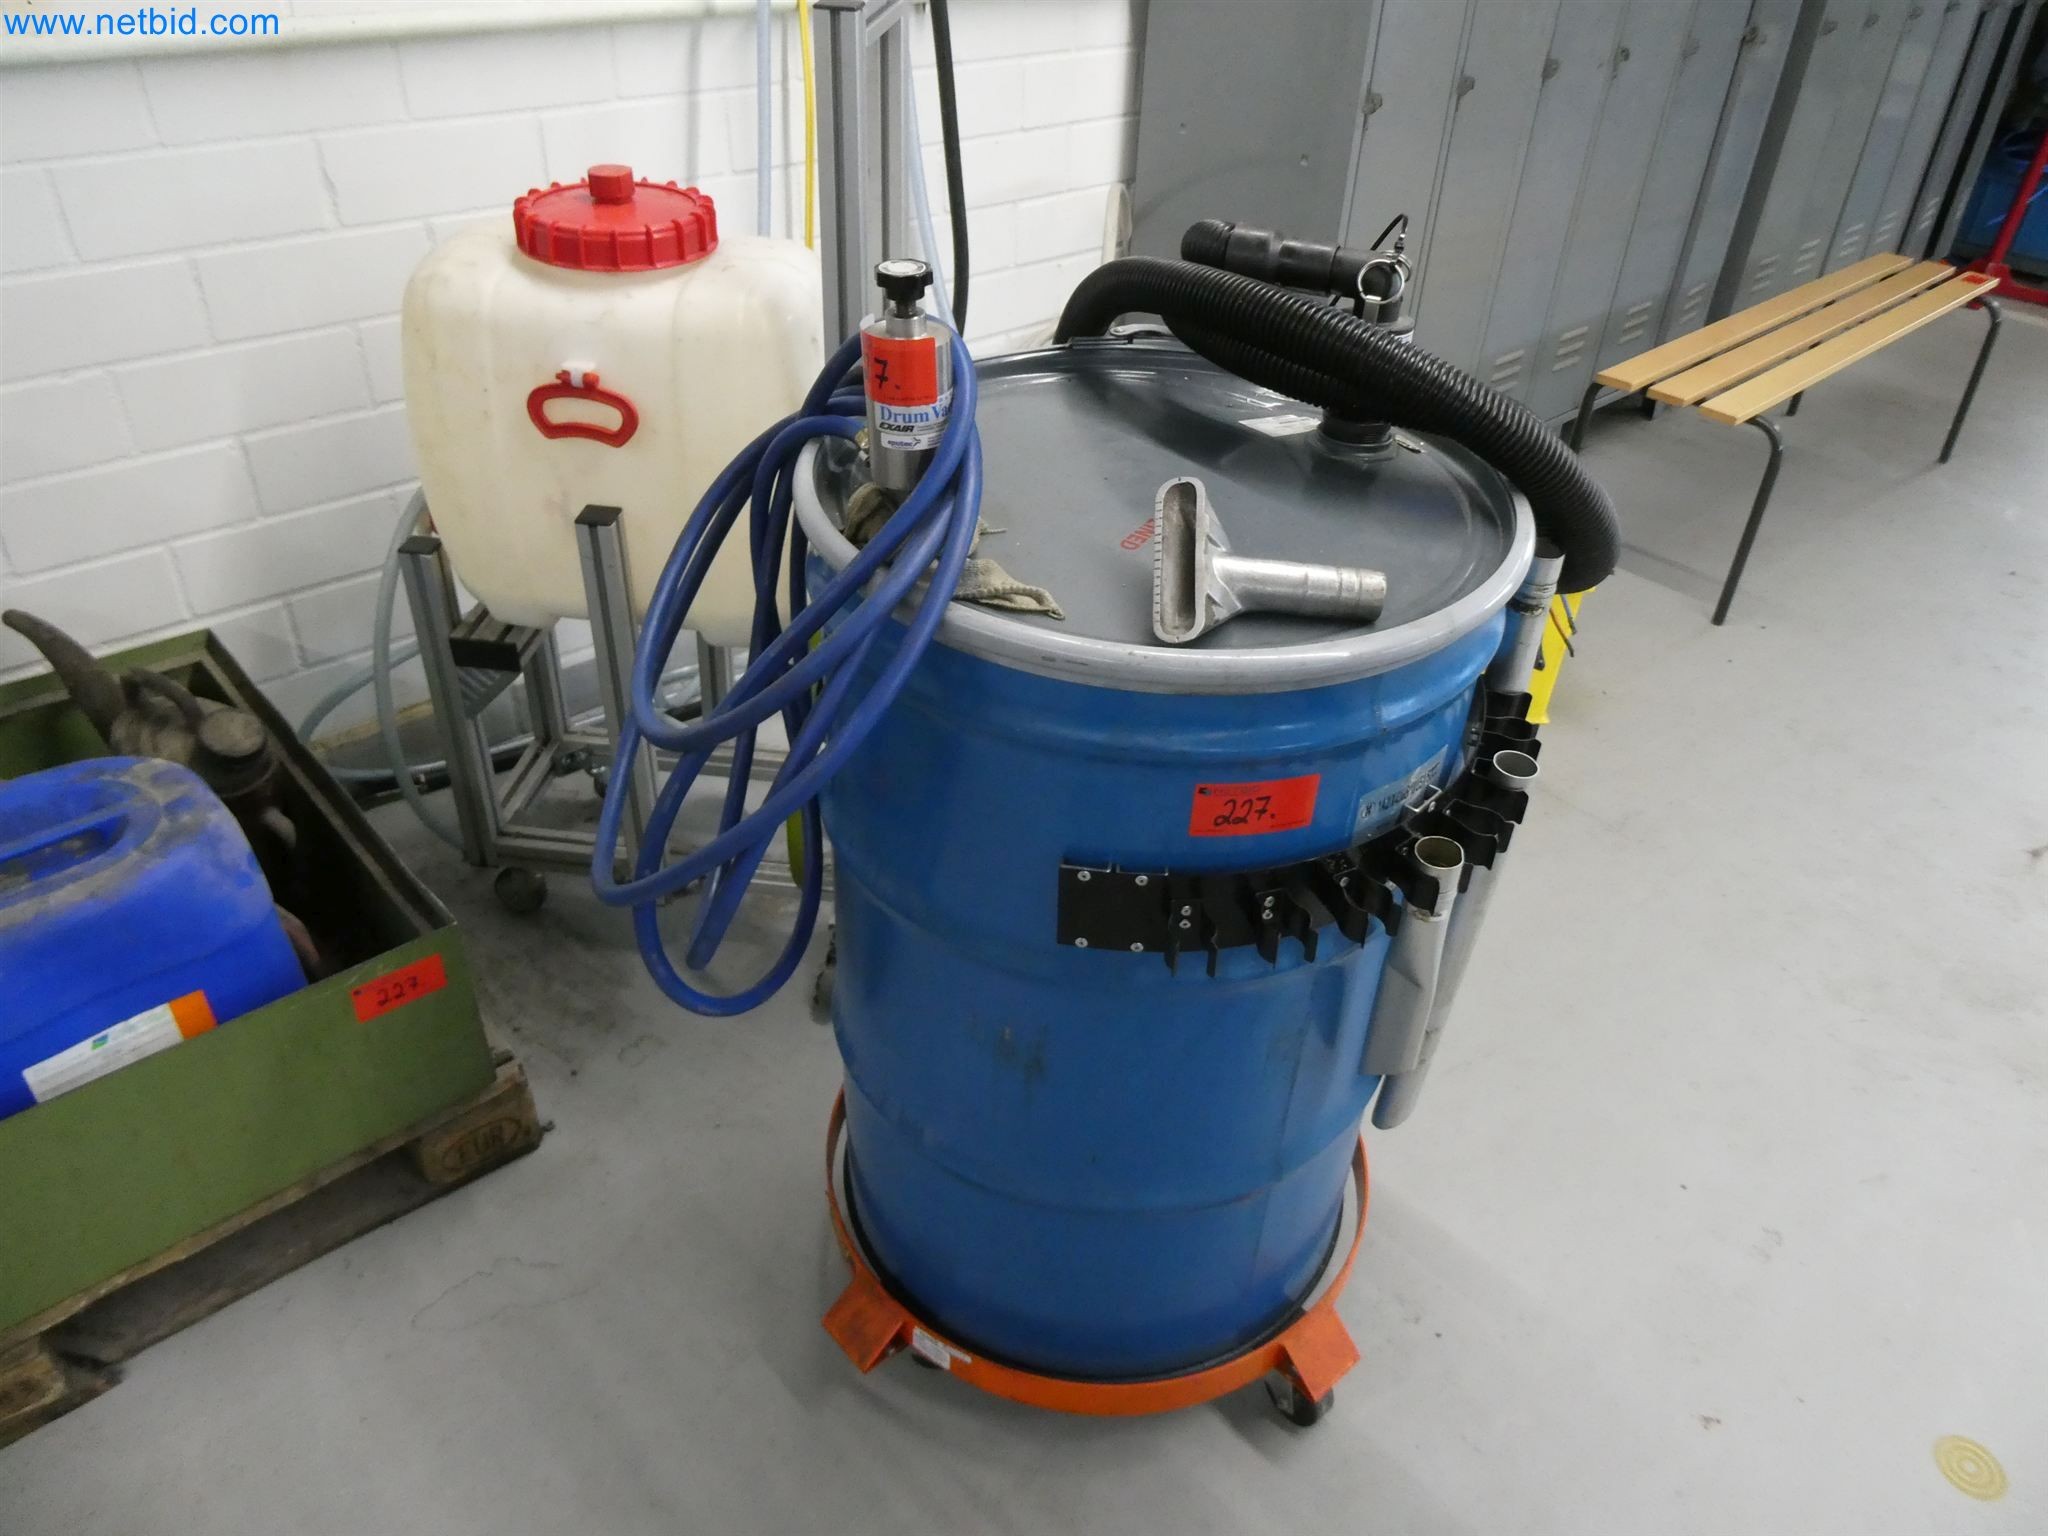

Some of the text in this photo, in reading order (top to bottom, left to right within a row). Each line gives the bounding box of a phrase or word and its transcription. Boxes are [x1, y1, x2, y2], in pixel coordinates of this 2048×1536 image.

[873, 357, 901, 390] 7.
[879, 403, 951, 424] Drum Va
[879, 421, 915, 433] EXAIR
